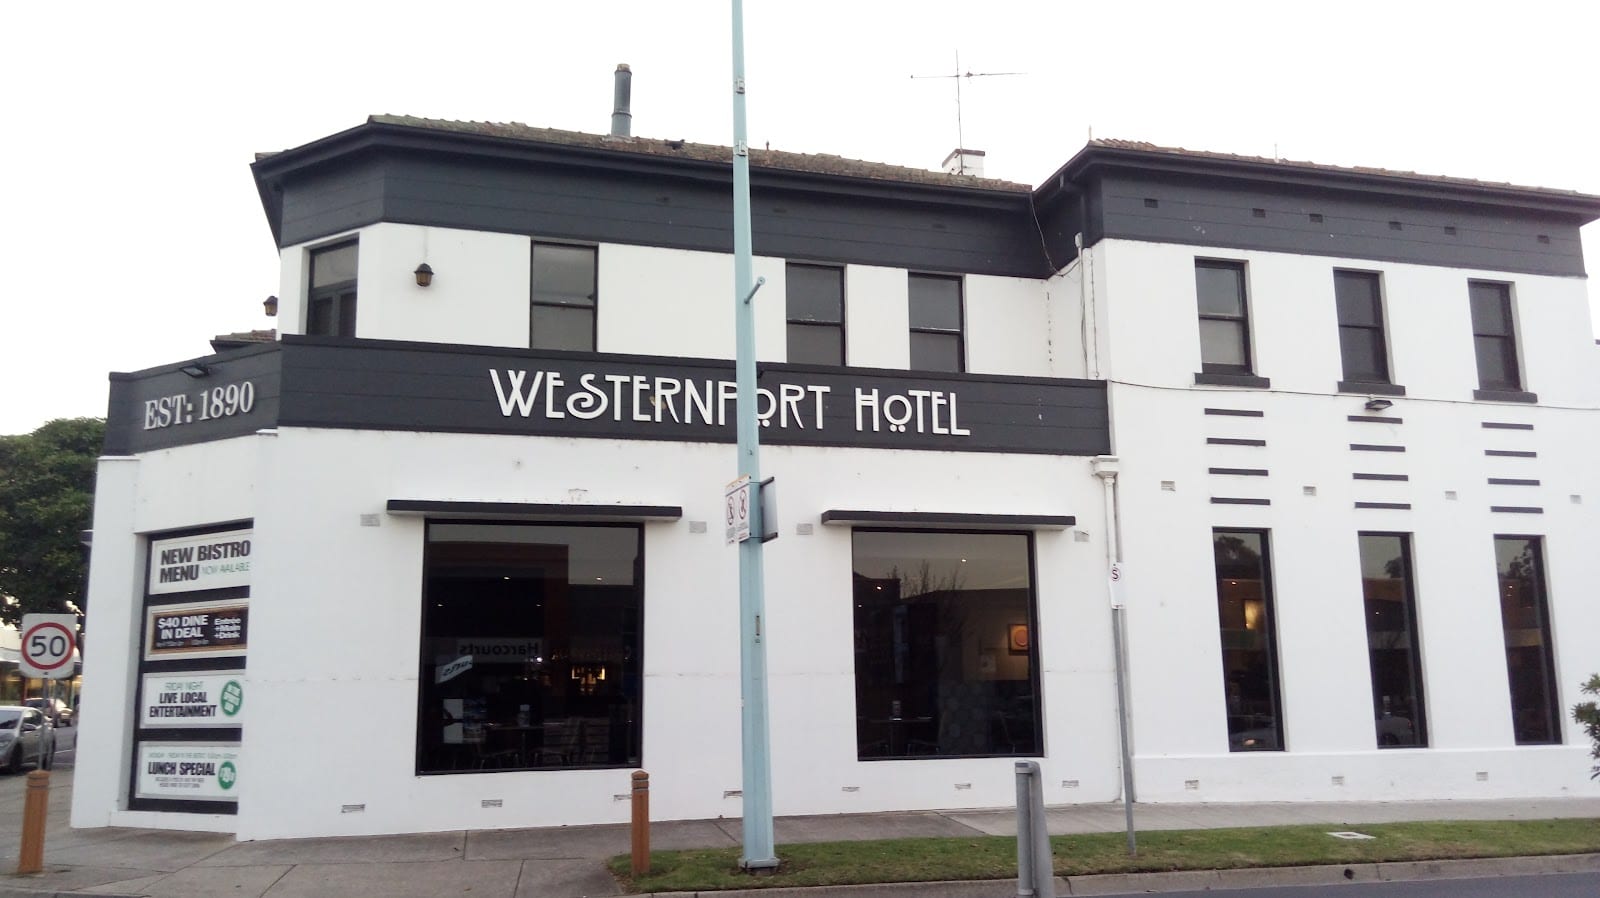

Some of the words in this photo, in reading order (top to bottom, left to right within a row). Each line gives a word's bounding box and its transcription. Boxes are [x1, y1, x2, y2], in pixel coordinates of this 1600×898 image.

[143, 394, 193, 430] EST:
[198, 381, 254, 421] 1890
[489, 368, 831, 430] WESTERNPORT
[855, 387, 970, 436] HOTEL
[161, 546, 194, 566] NEW
[197, 539, 252, 561] BISTRO
[160, 564, 200, 584] MENU
[158, 617, 180, 629] $40
[181, 614, 209, 627] DINE
[161, 629, 173, 640] IN
[175, 626, 205, 638] DEAL
[31, 635, 66, 657] 50
[159, 692, 178, 704] LIVE
[180, 691, 208, 703] LOCAL
[149, 705, 217, 717] ENTERTAINMENT
[148, 761, 177, 775] LUNCH
[179, 762, 216, 776] SPECIAL
